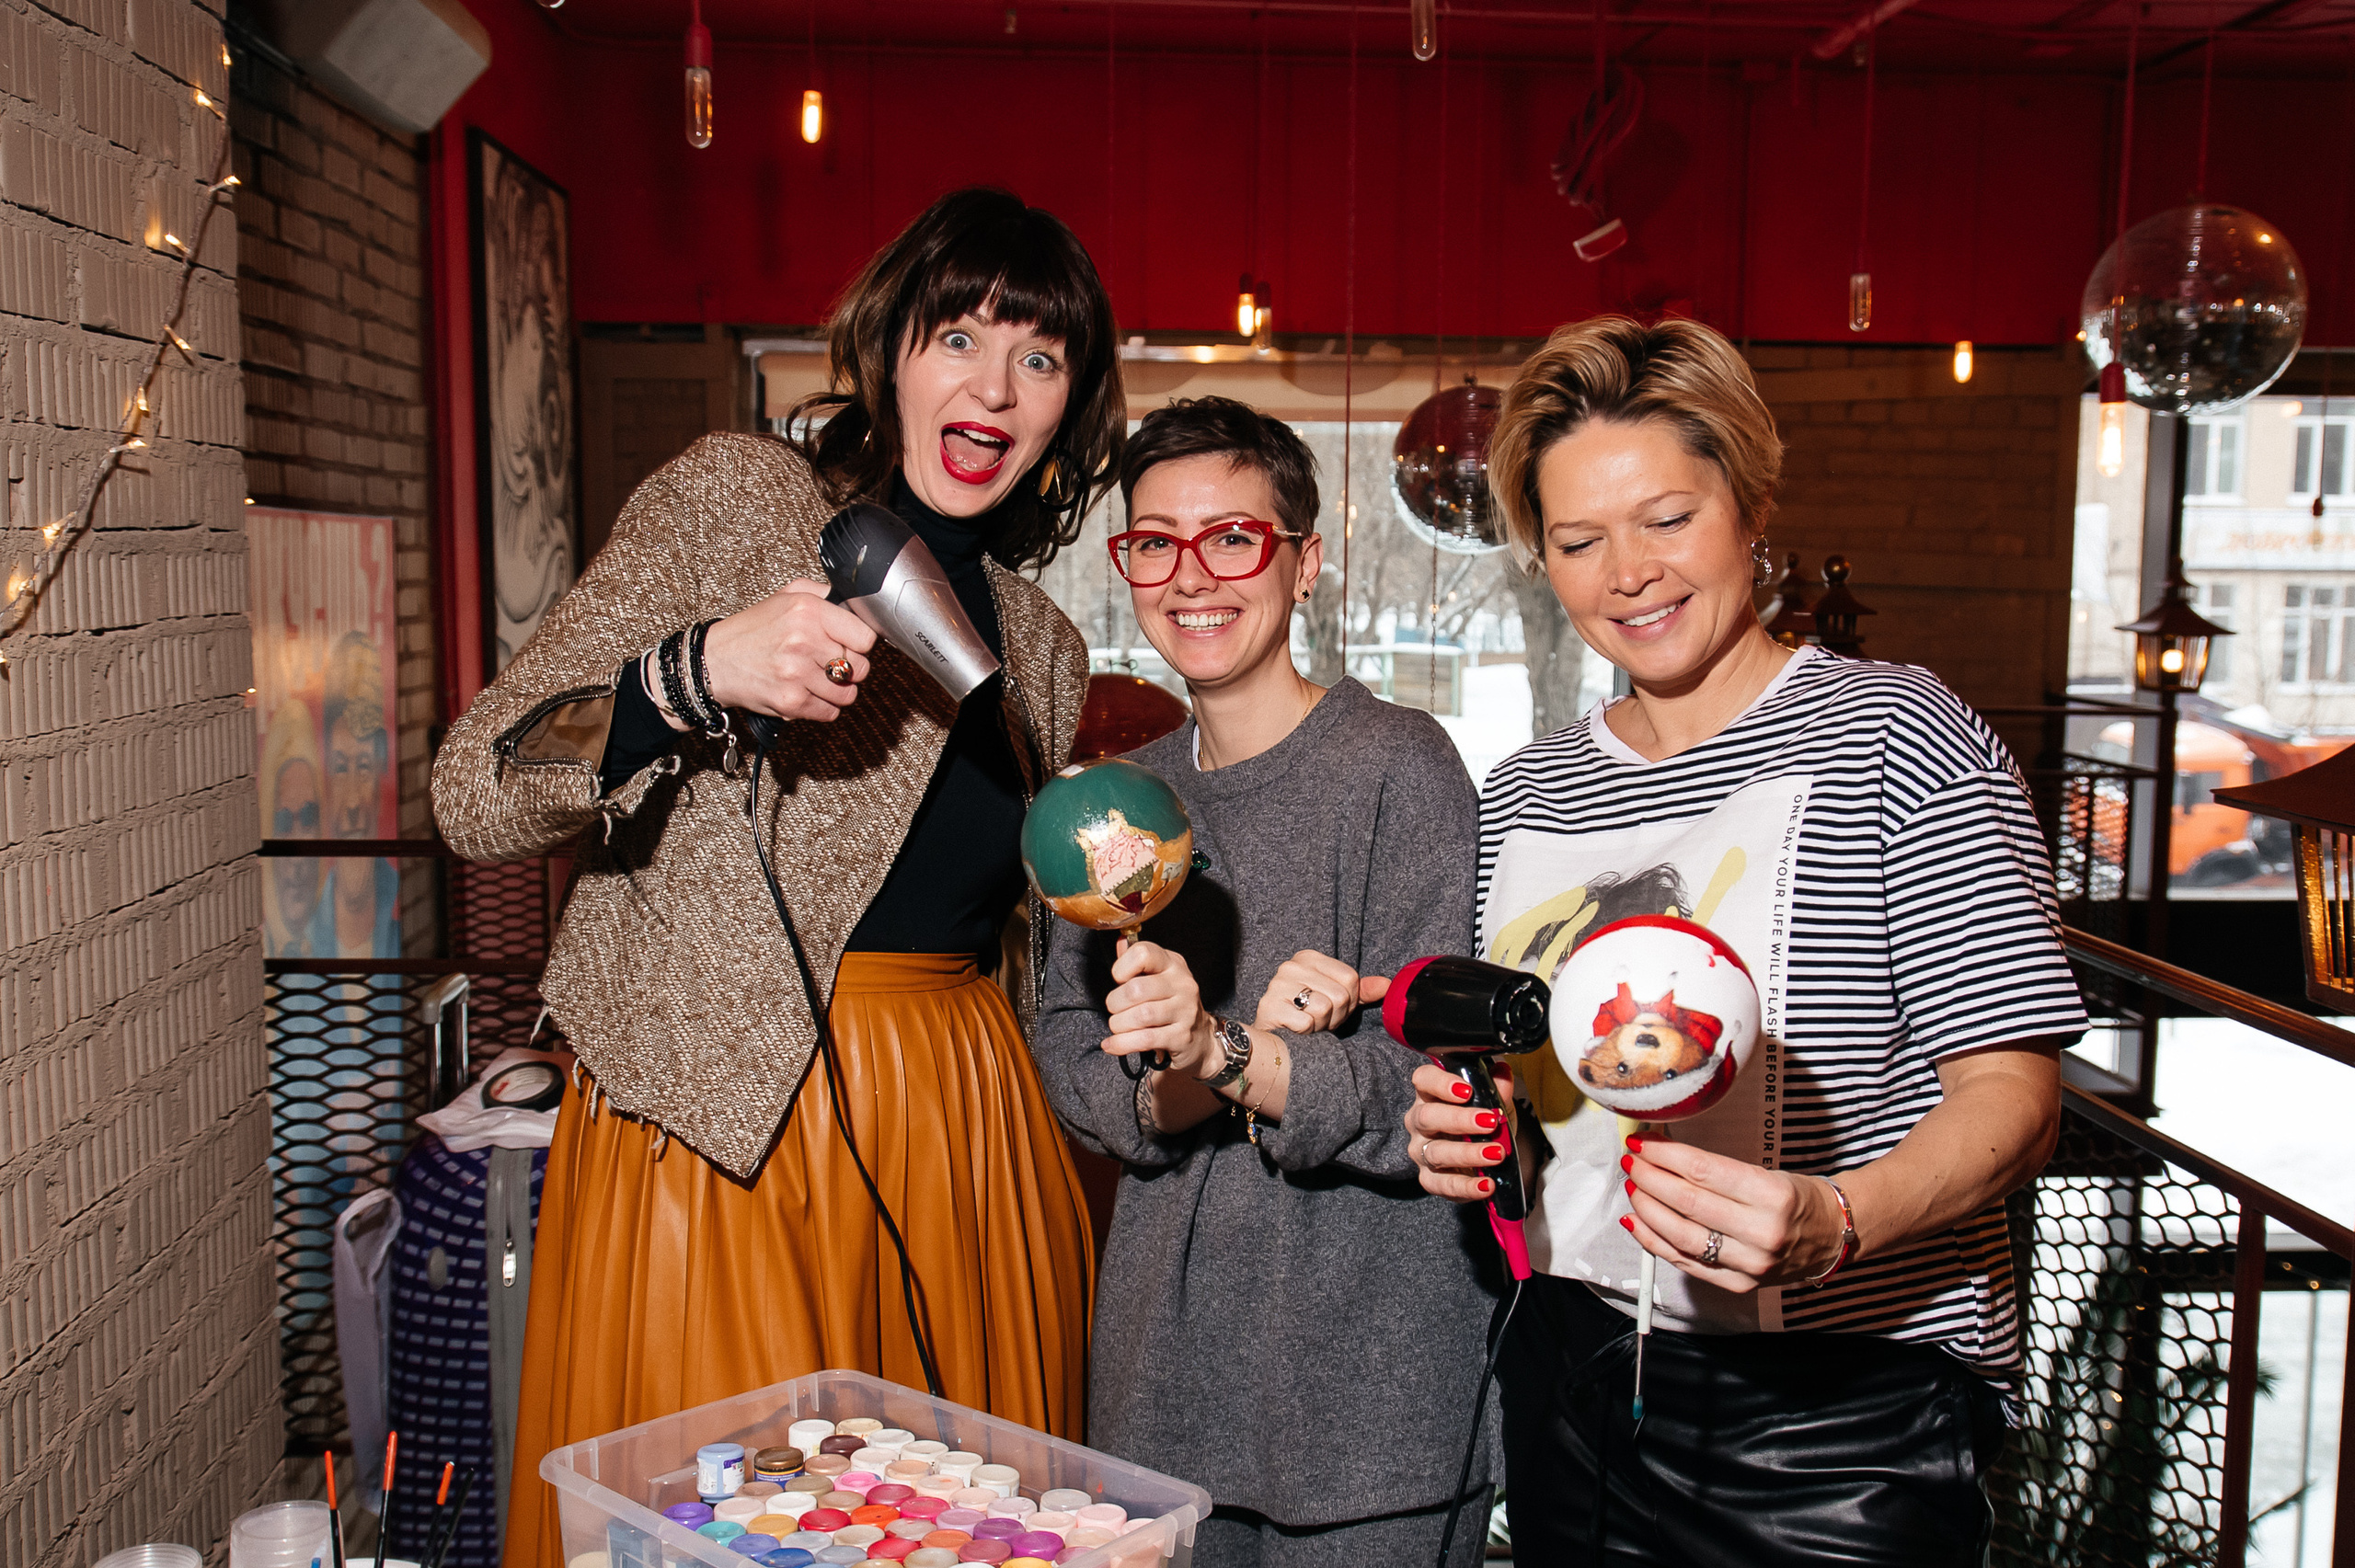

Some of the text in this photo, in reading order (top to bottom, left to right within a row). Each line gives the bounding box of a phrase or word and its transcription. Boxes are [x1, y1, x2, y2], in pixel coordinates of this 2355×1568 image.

[914, 631, 949, 663] SCARLETT
[1789, 795, 1803, 821] ONE
[1782, 827, 1795, 851] DAY
[1775, 857, 1788, 898] YOUR
[1772, 904, 1784, 936] LIFE
[1769, 943, 1781, 981] WILL
[1766, 988, 1778, 1038] FLASH
[1764, 1044, 1776, 1103] BEFORE
[1763, 1108, 1775, 1151] YOUR
